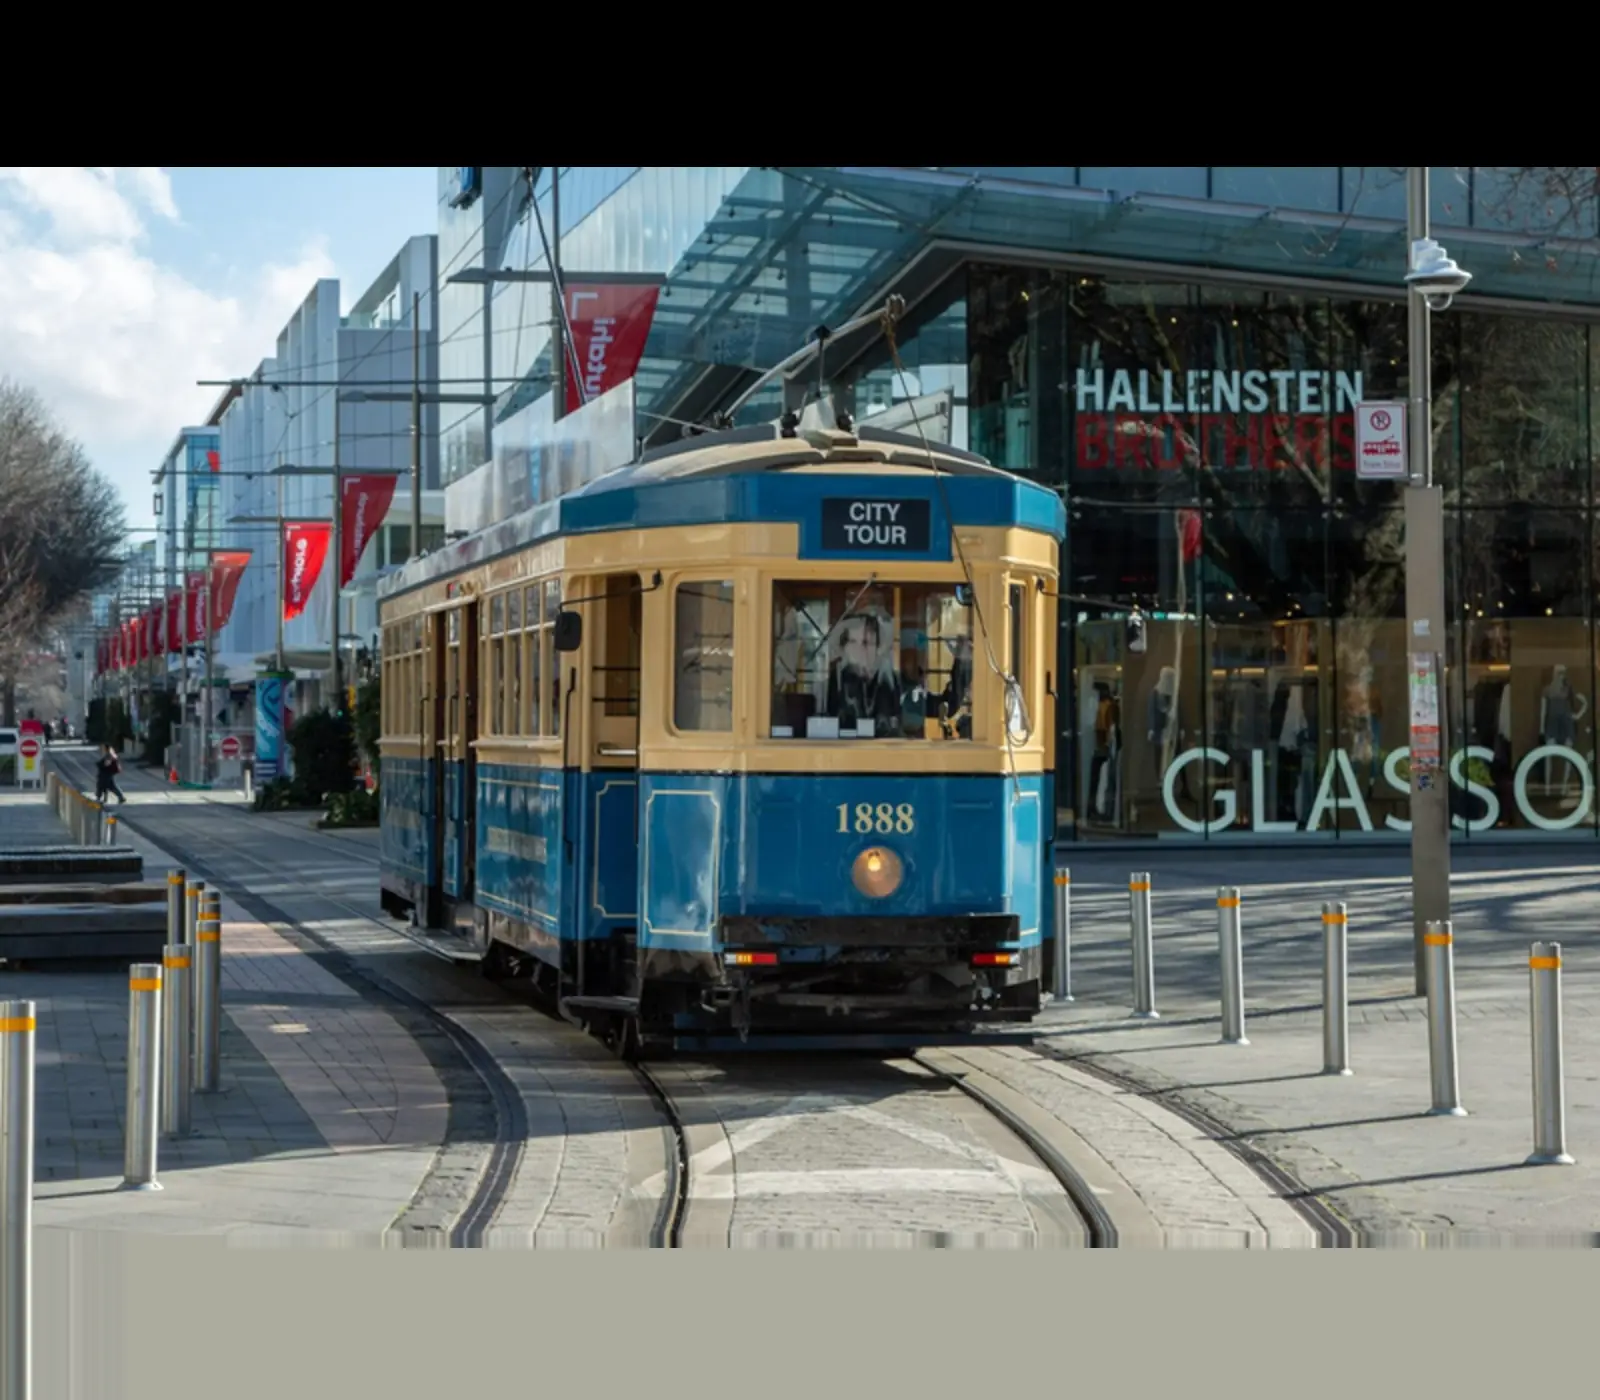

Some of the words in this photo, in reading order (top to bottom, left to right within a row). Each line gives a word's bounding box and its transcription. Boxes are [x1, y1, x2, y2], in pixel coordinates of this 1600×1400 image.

[1076, 368, 1363, 412] HALLENSTEIN
[1076, 413, 1356, 470] BROTHERS
[849, 501, 901, 522] CITY
[843, 524, 907, 545] TOUR
[835, 802, 914, 834] 1888
